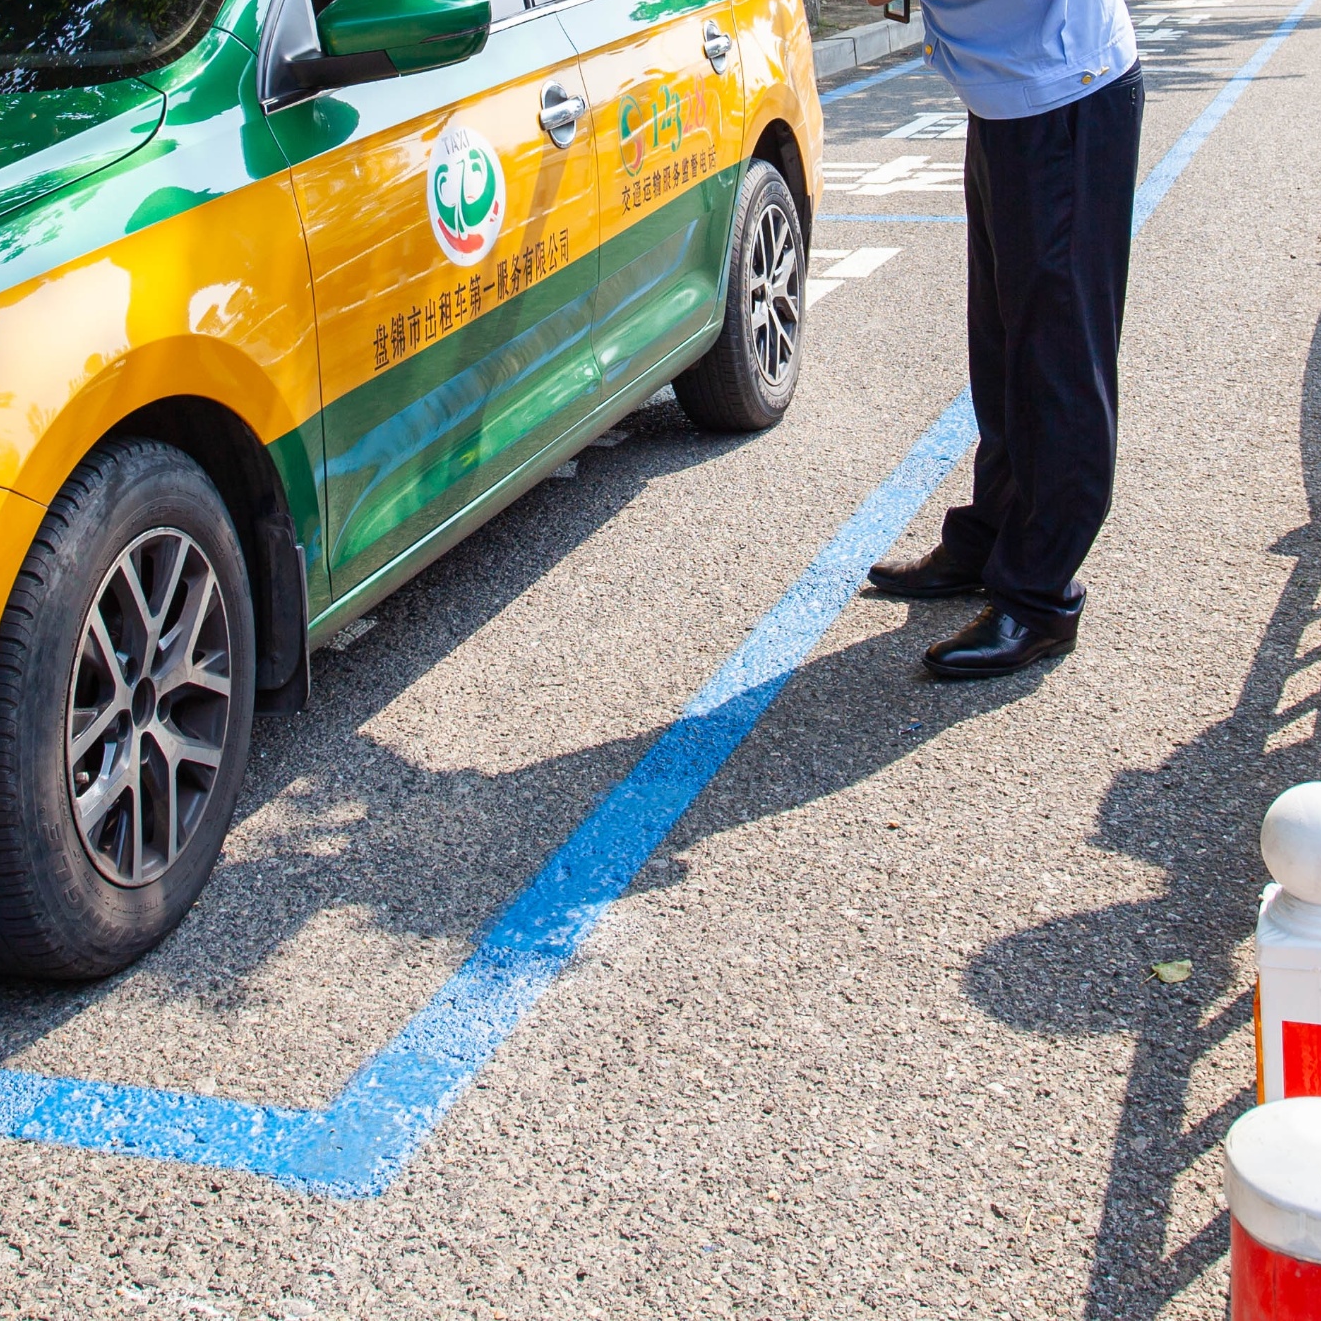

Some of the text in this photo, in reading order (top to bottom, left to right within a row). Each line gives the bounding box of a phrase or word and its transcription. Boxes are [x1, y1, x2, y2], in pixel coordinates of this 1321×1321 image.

[441, 129, 470, 155] TAXI
[651, 72, 707, 153] 12328
[621, 144, 716, 216] 交通运输服务监督电话
[373, 227, 570, 372] 盘锦市出租车第一服务有限公司
